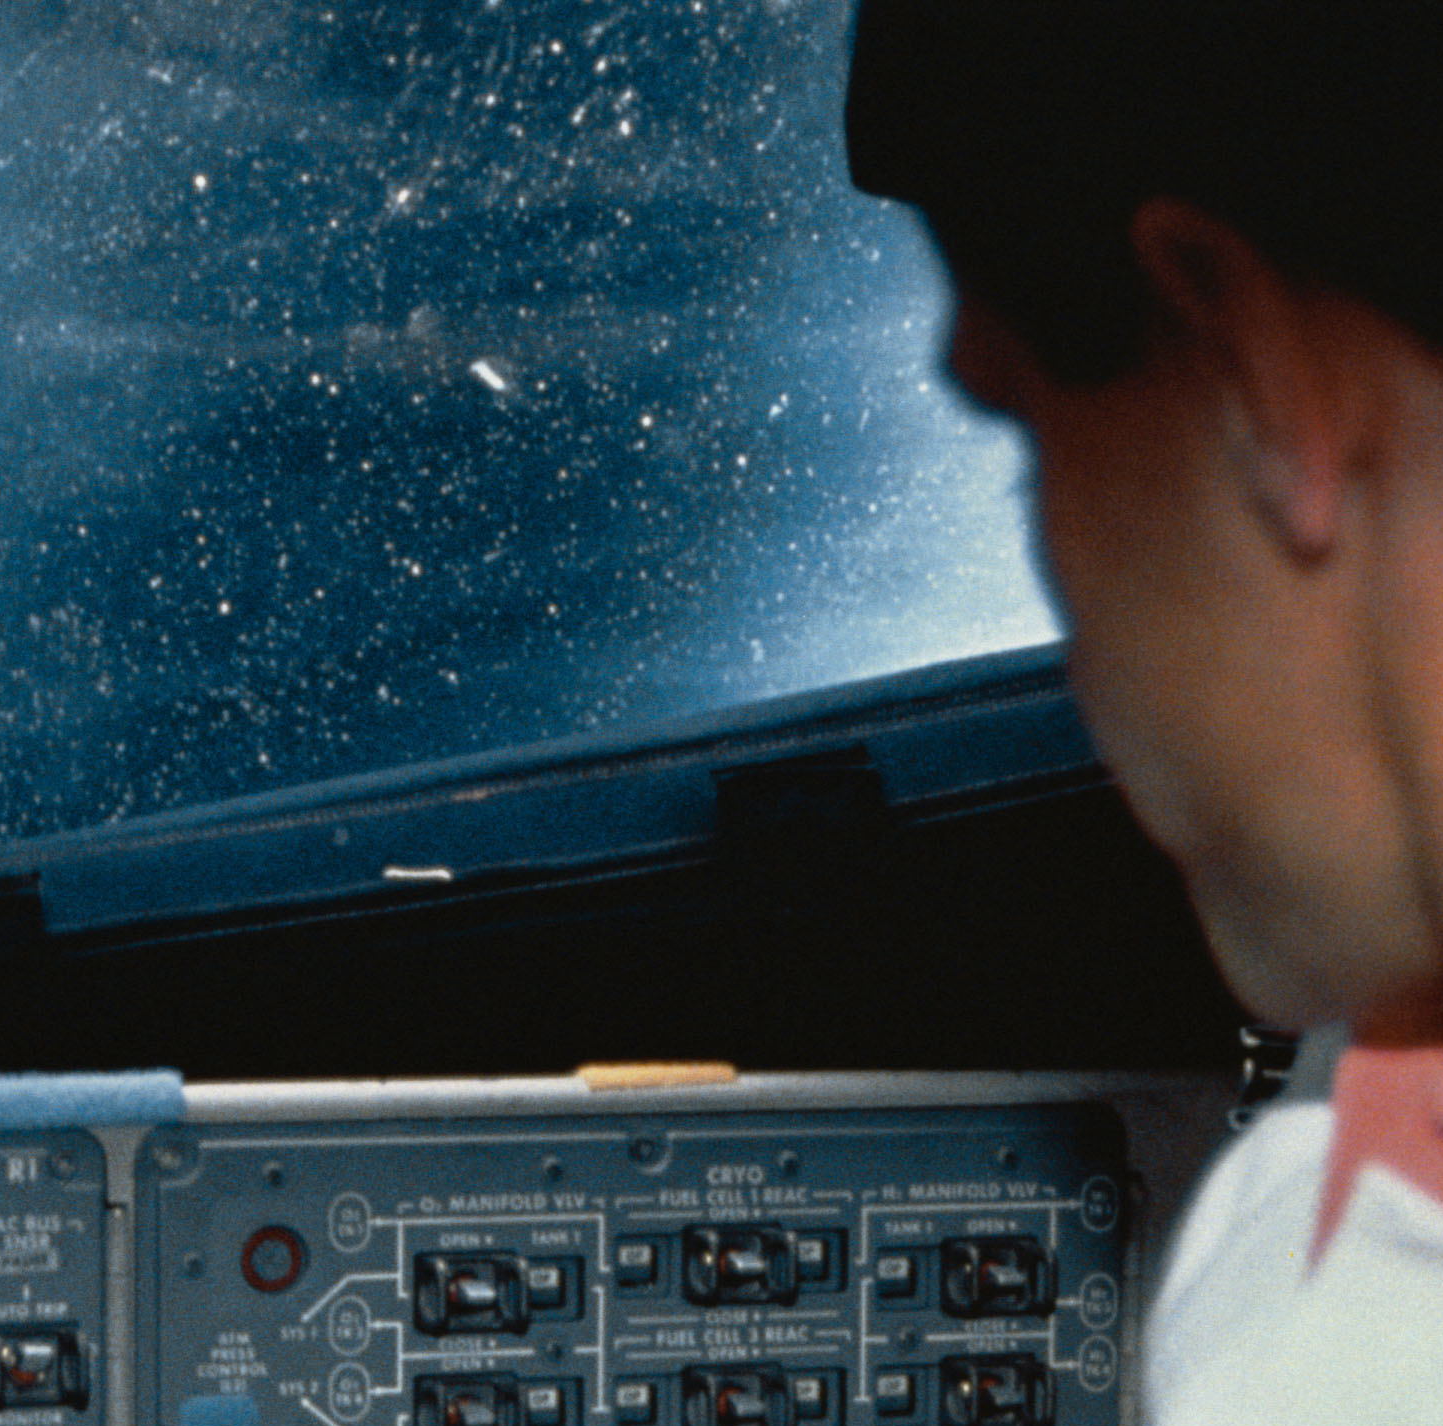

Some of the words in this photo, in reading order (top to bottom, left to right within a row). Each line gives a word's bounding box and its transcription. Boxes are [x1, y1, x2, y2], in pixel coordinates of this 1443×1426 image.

[707, 1167, 763, 1185] CRYO
[660, 1191, 698, 1206] FUEL
[706, 1190, 740, 1205] CELL
[763, 1188, 806, 1203] REAC
[909, 1184, 1000, 1198] MANIFOLD
[451, 1196, 546, 1211] MANIFOLD
[656, 1330, 695, 1346] FUEL
[704, 1330, 739, 1344] CELL
[765, 1327, 806, 1342] REAC
